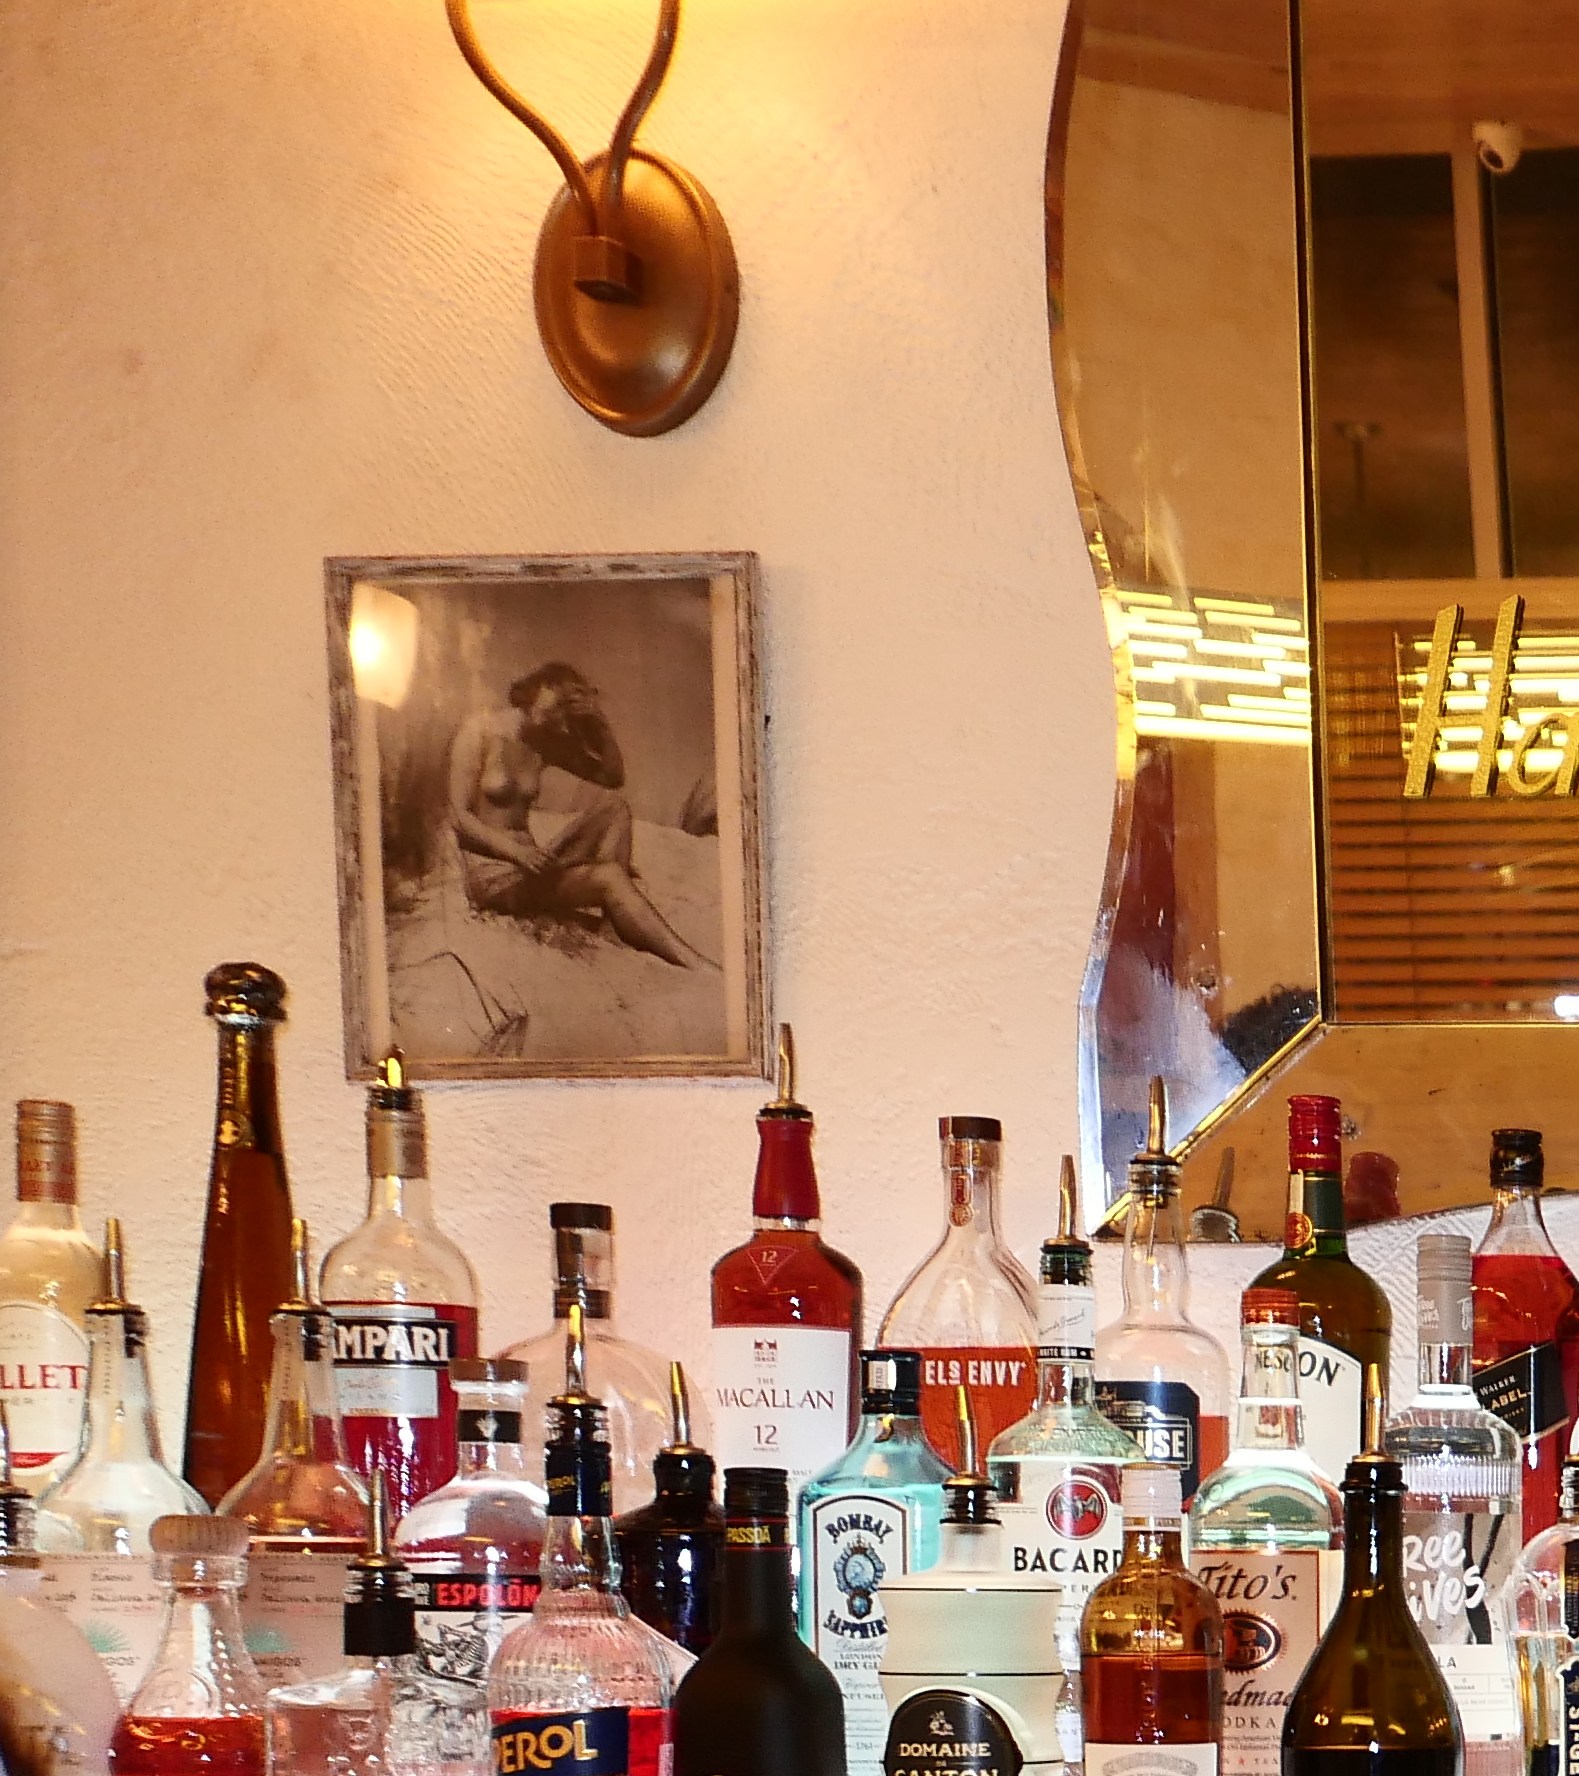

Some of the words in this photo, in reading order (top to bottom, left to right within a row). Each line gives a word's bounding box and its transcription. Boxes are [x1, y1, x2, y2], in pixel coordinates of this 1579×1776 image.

[335, 1324, 450, 1361] MPARI
[0, 1364, 89, 1389] LLET
[925, 1359, 961, 1385] ELS
[716, 1387, 834, 1410] MACALLAN
[753, 1424, 778, 1445] 12
[824, 1513, 895, 1544] BOMBAY
[500, 1718, 599, 1774] EROL
[899, 1742, 991, 1758] DOMAINE
